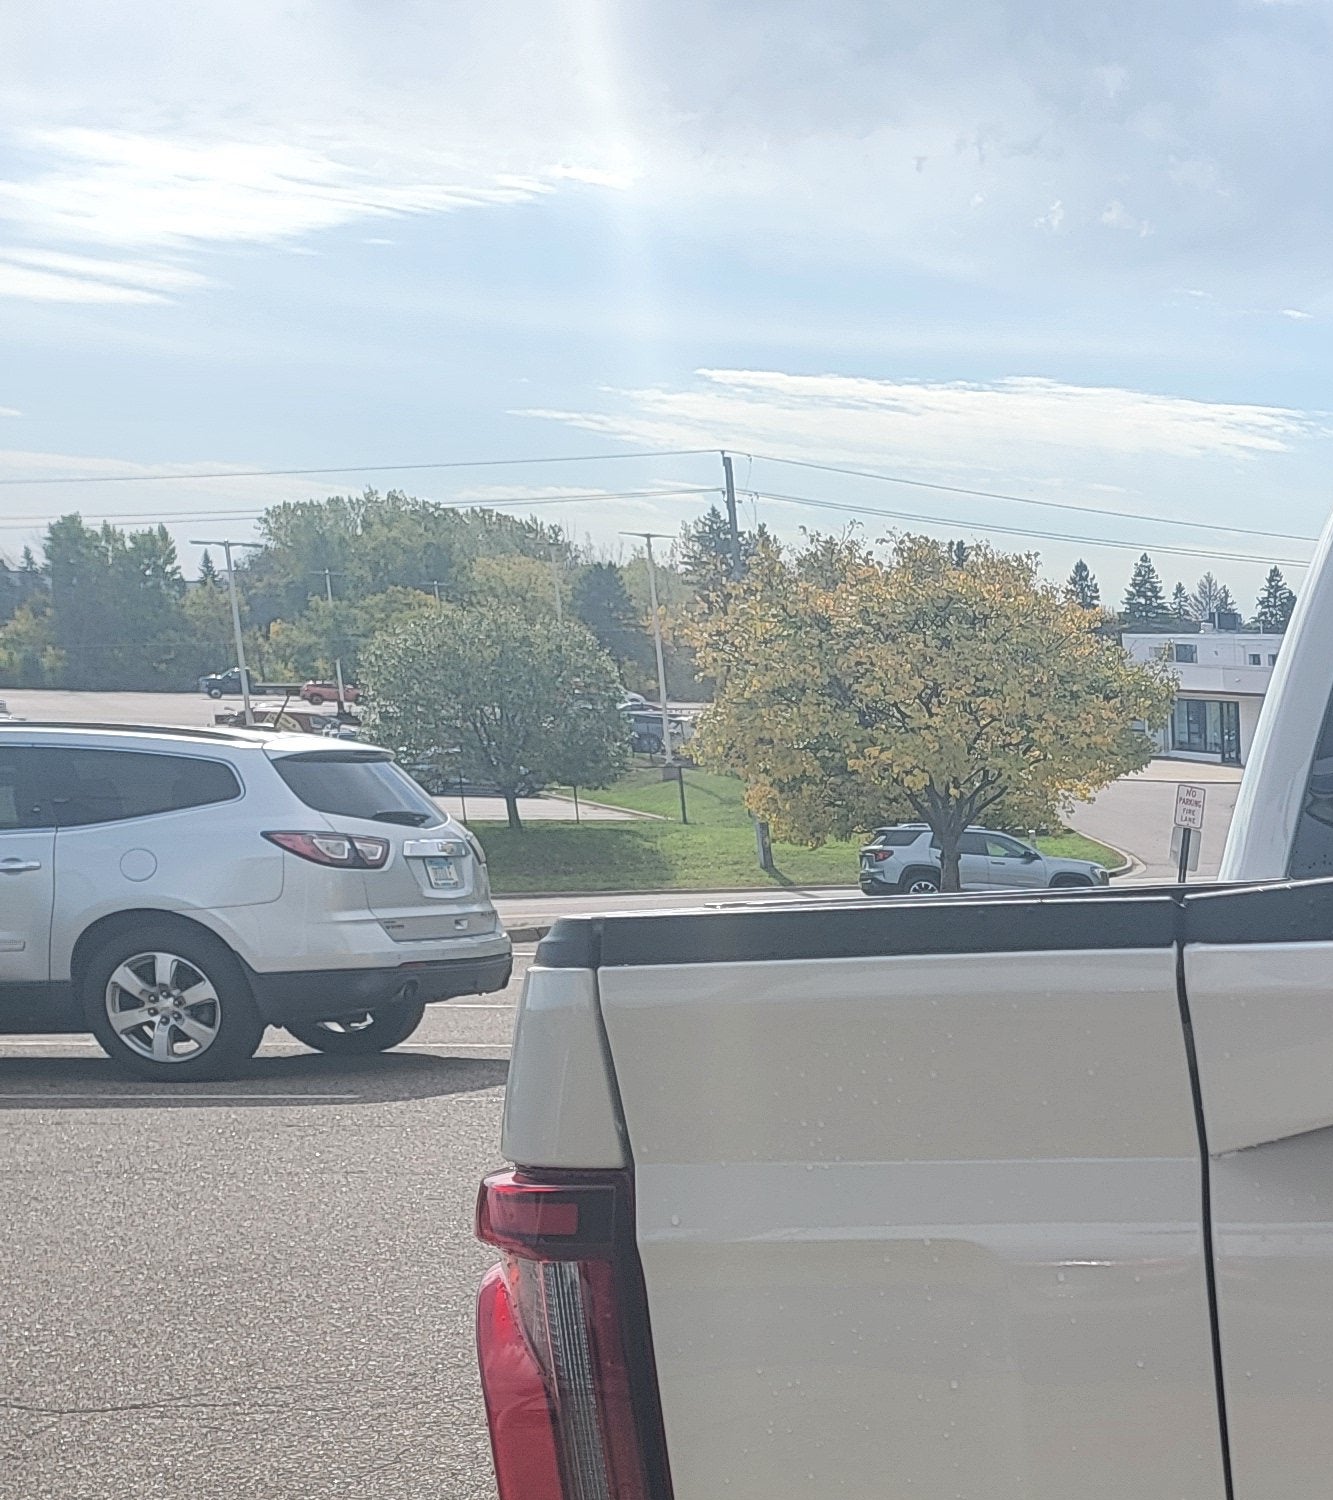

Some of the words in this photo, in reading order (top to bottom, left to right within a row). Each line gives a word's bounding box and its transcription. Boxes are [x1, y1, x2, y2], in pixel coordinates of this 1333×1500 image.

[1186, 789, 1196, 798] NO
[1179, 797, 1202, 808] PARKING
[1183, 808, 1195, 816] FIRE
[1181, 816, 1195, 824] LANE
